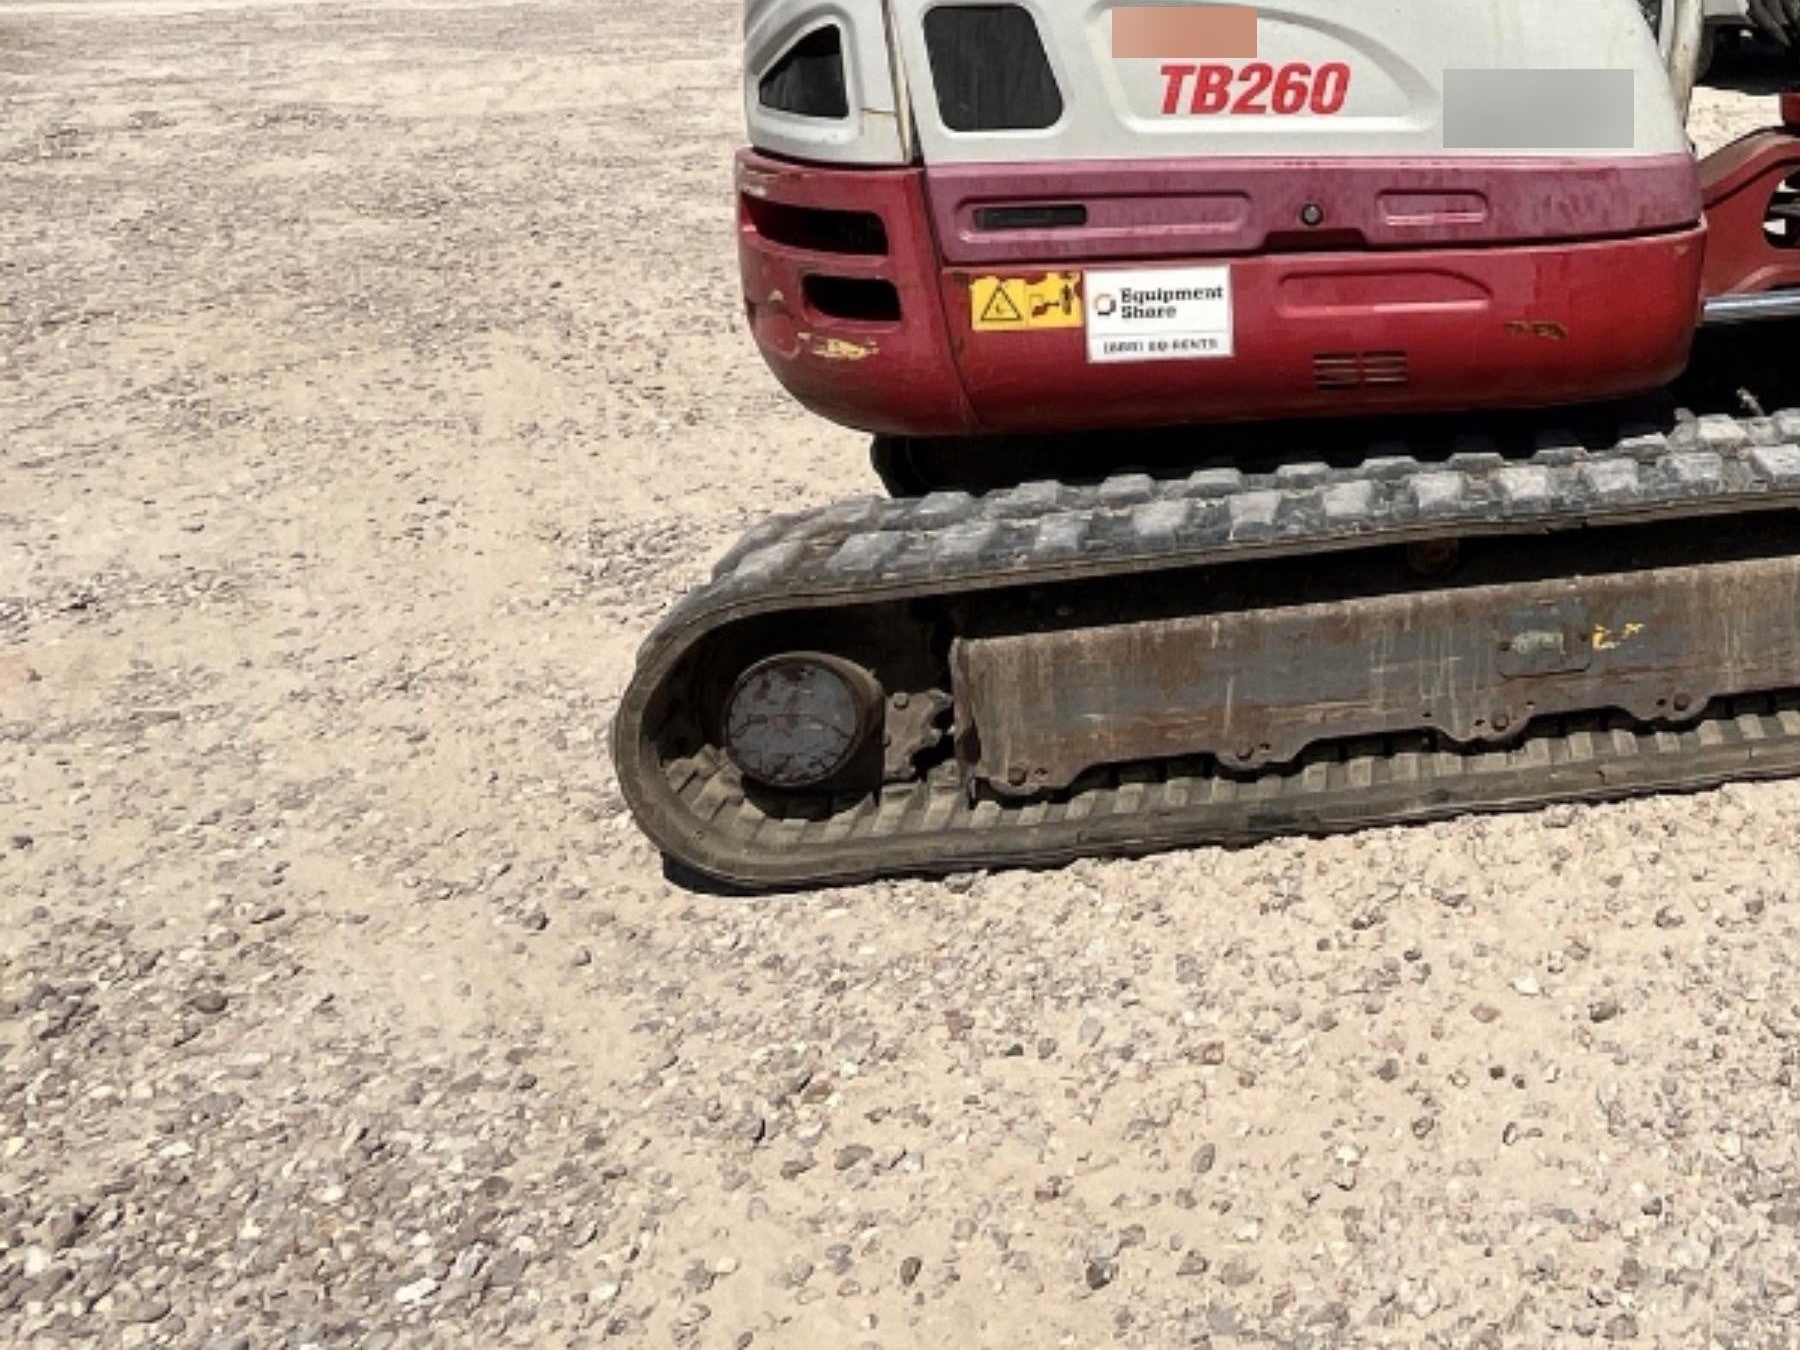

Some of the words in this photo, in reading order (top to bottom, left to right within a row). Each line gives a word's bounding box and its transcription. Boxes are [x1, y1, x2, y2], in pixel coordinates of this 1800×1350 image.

[1159, 61, 1351, 116] TB260
[1120, 285, 1224, 305] Equipment
[1120, 305, 1177, 320] Share
